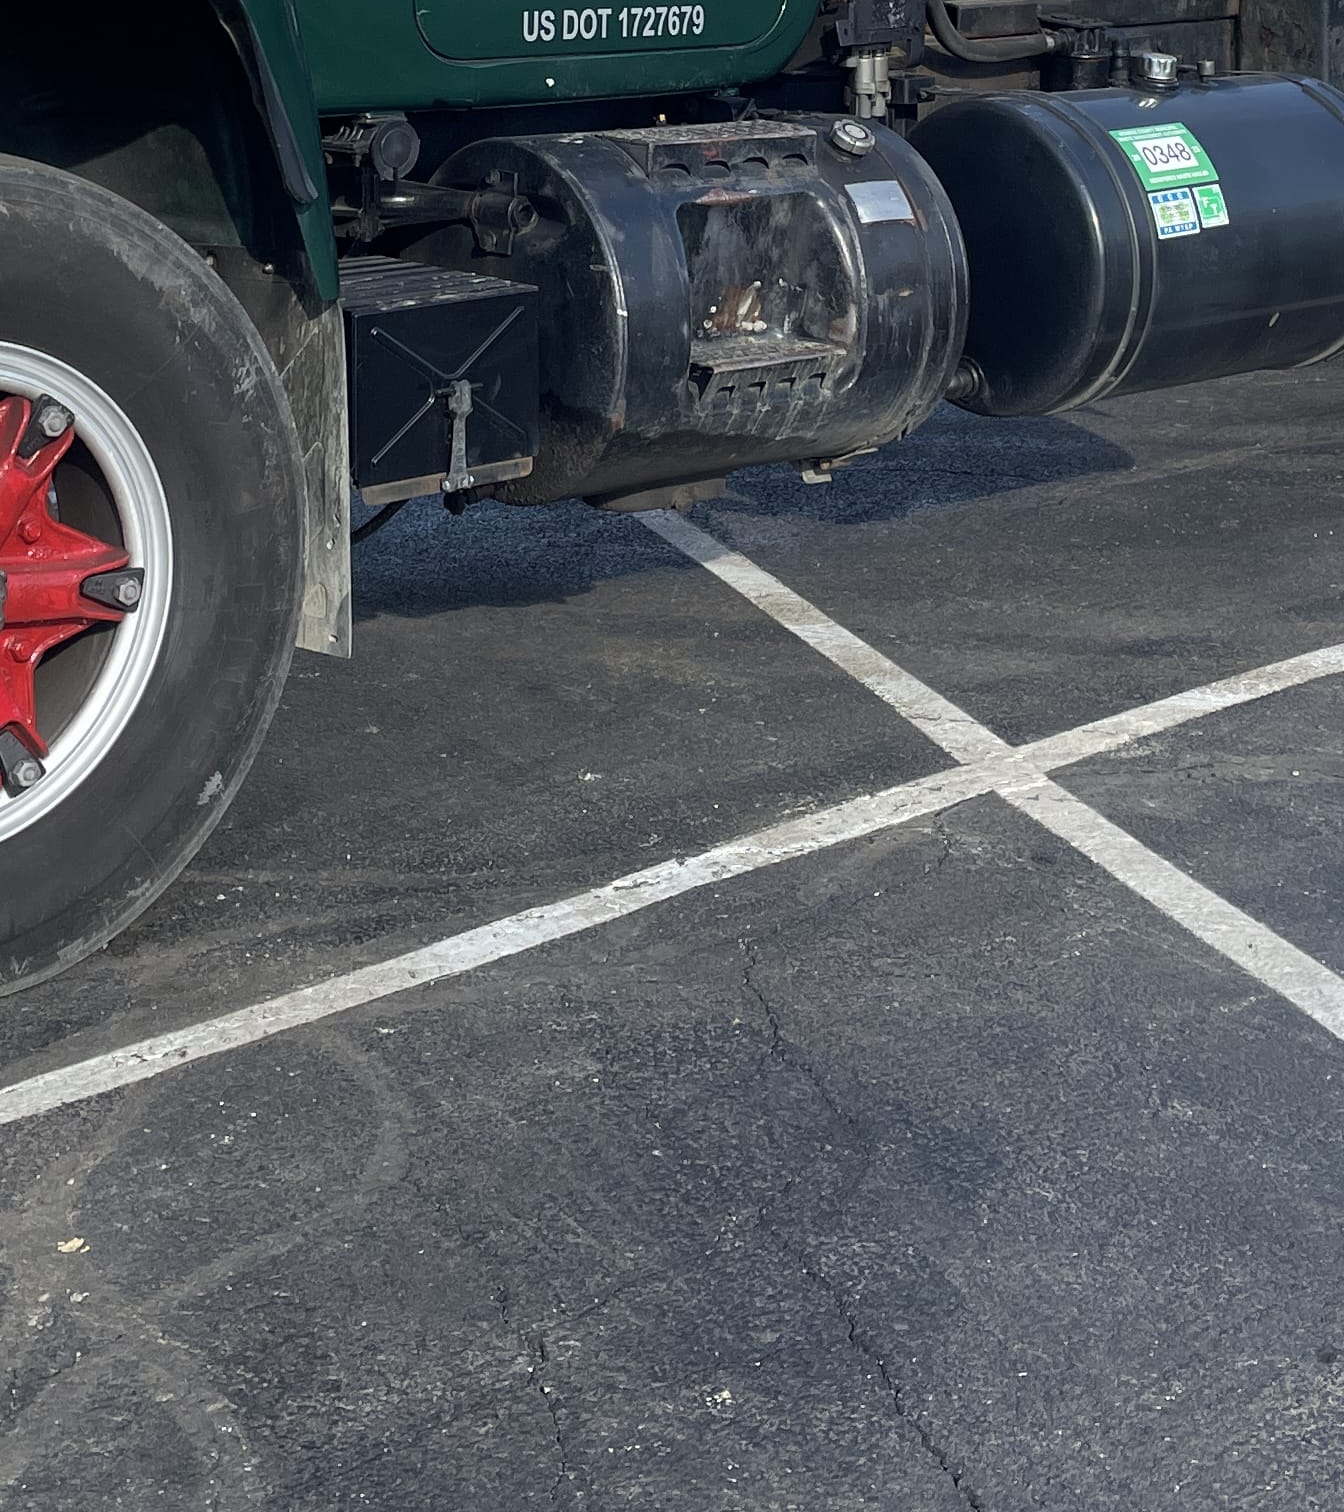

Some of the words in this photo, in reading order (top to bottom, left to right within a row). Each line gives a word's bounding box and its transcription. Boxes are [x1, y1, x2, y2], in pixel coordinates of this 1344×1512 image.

[522, 9, 555, 42] US
[562, 8, 612, 40] DOT
[618, 4, 705, 38] 1727679
[1141, 141, 1192, 166] 0348
